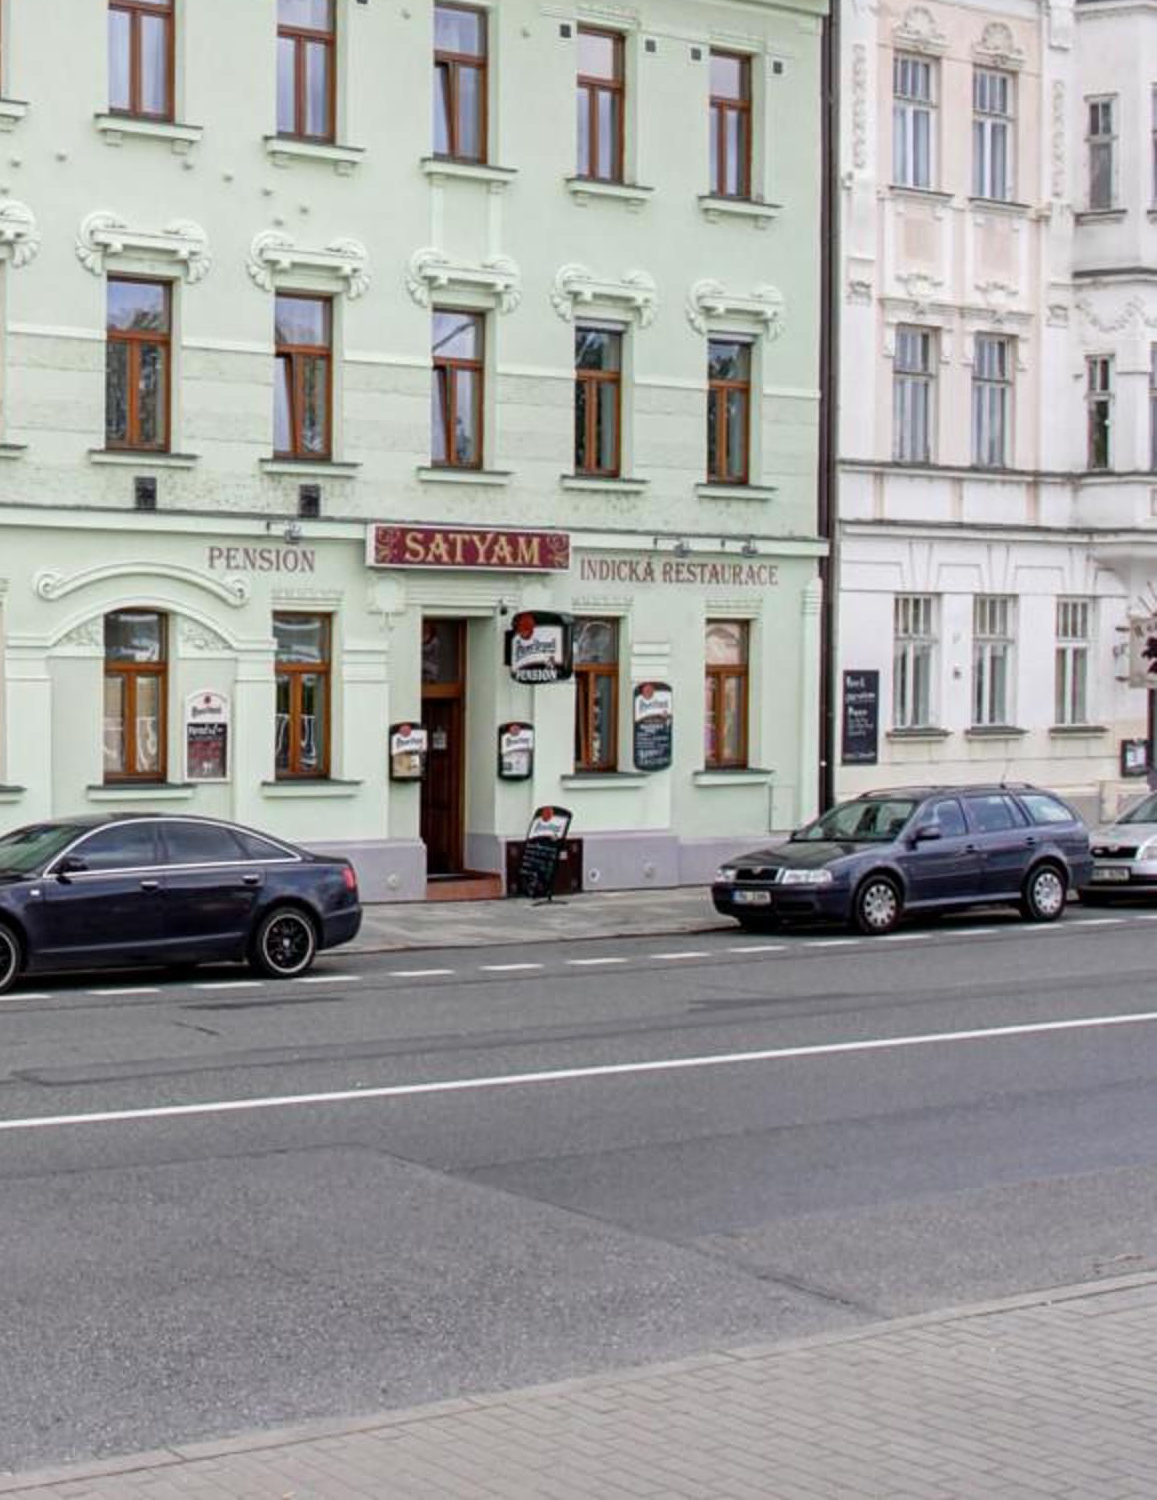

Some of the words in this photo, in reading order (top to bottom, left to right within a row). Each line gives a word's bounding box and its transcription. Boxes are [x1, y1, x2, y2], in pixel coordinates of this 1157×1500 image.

[208, 547, 315, 572] PENSION
[404, 532, 541, 565] SATYAM
[580, 556, 655, 583] INDICKÁ
[662, 562, 778, 586] RESTAURACE
